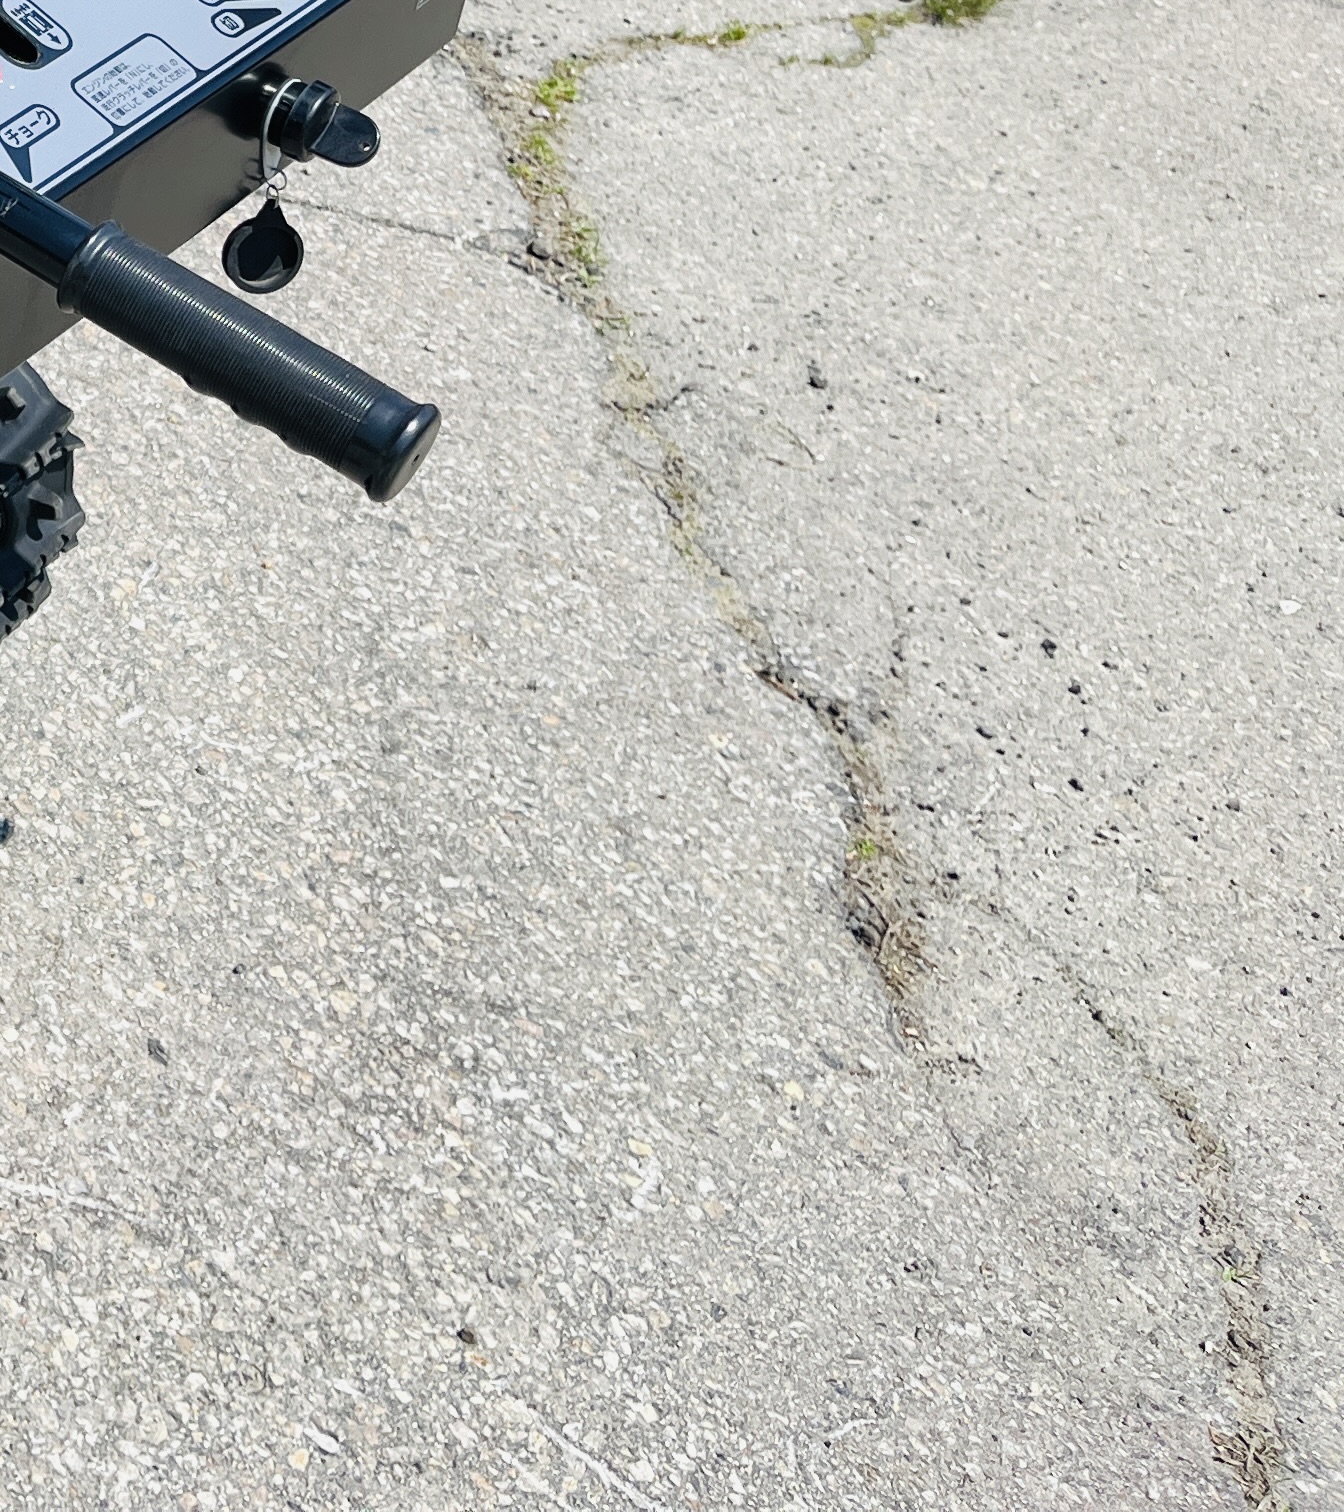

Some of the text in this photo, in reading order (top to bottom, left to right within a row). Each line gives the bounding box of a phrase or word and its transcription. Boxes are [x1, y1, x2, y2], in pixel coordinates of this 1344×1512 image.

[220, 14, 241, 32] 切
[6, 109, 52, 145] チョーク
